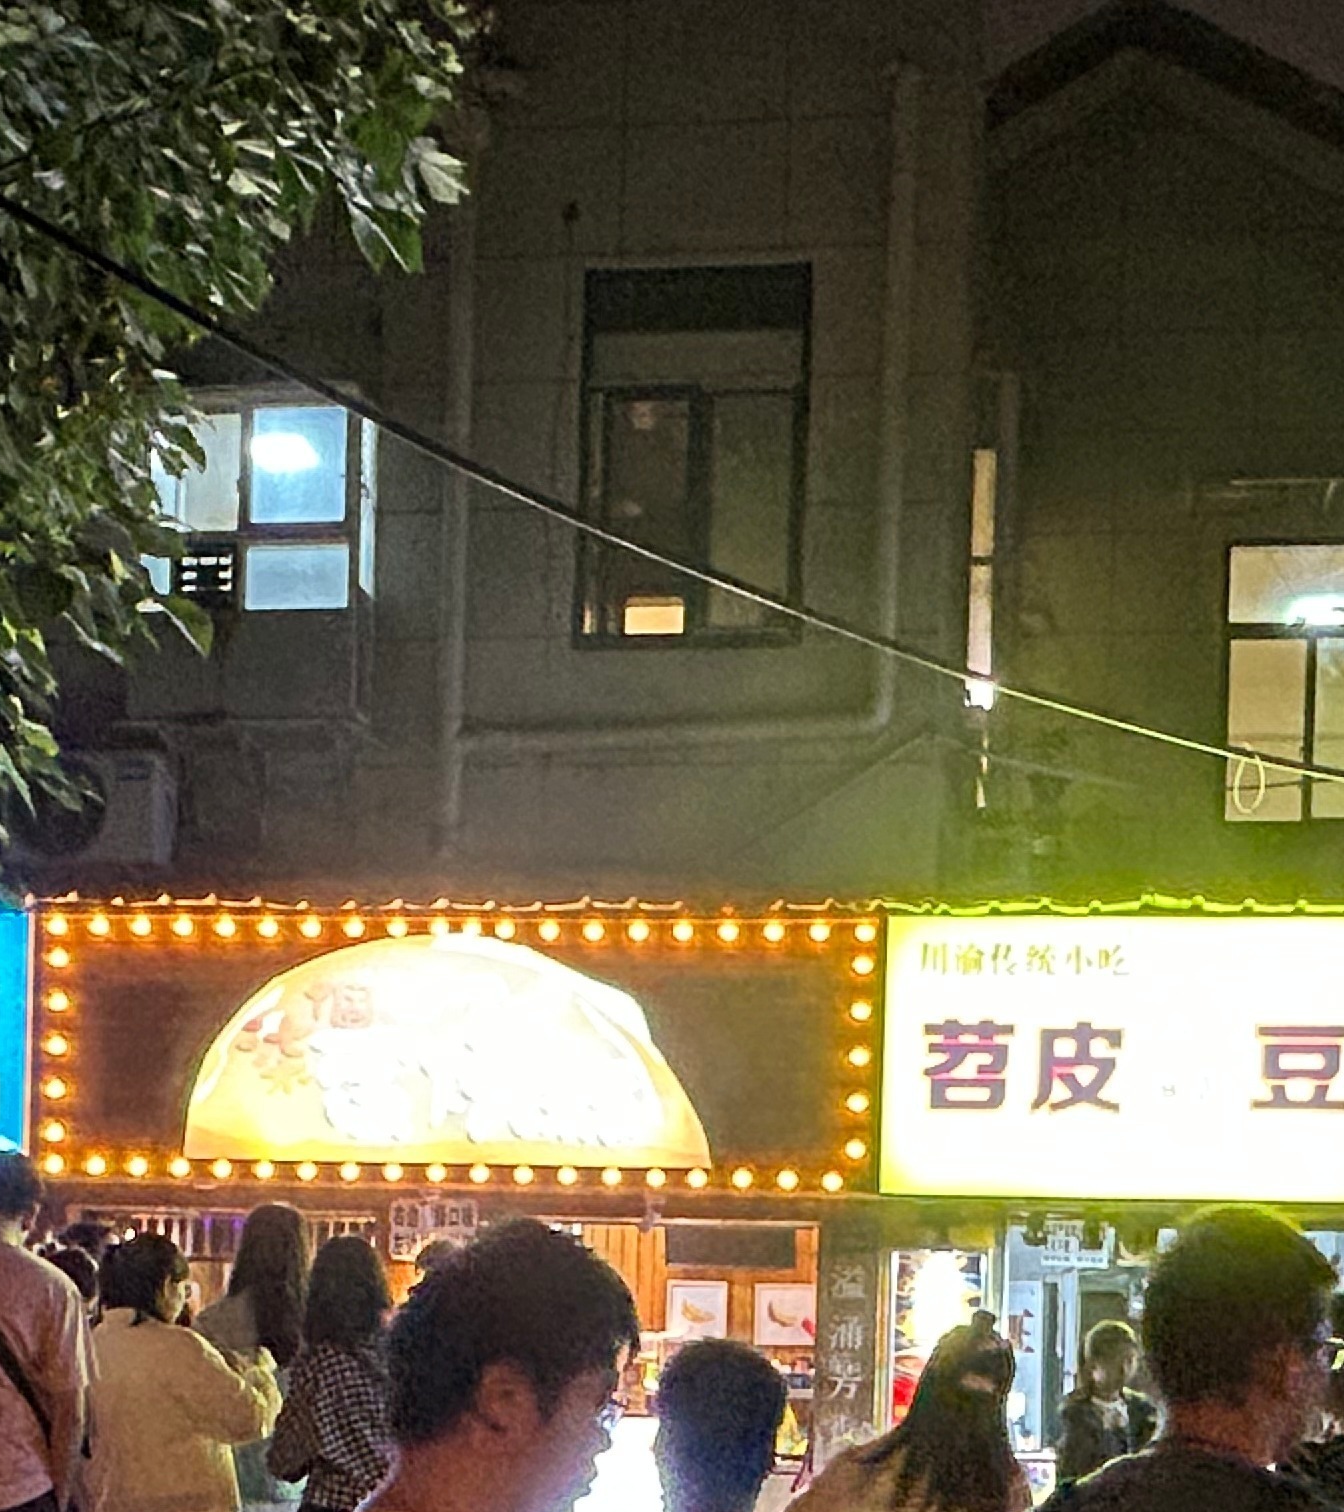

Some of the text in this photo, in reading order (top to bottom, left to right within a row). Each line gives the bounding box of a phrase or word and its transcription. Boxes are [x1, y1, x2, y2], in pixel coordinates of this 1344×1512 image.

[920, 942, 1130, 976] 川渝传统小吃
[921, 1018, 1125, 1115] 苕皮
